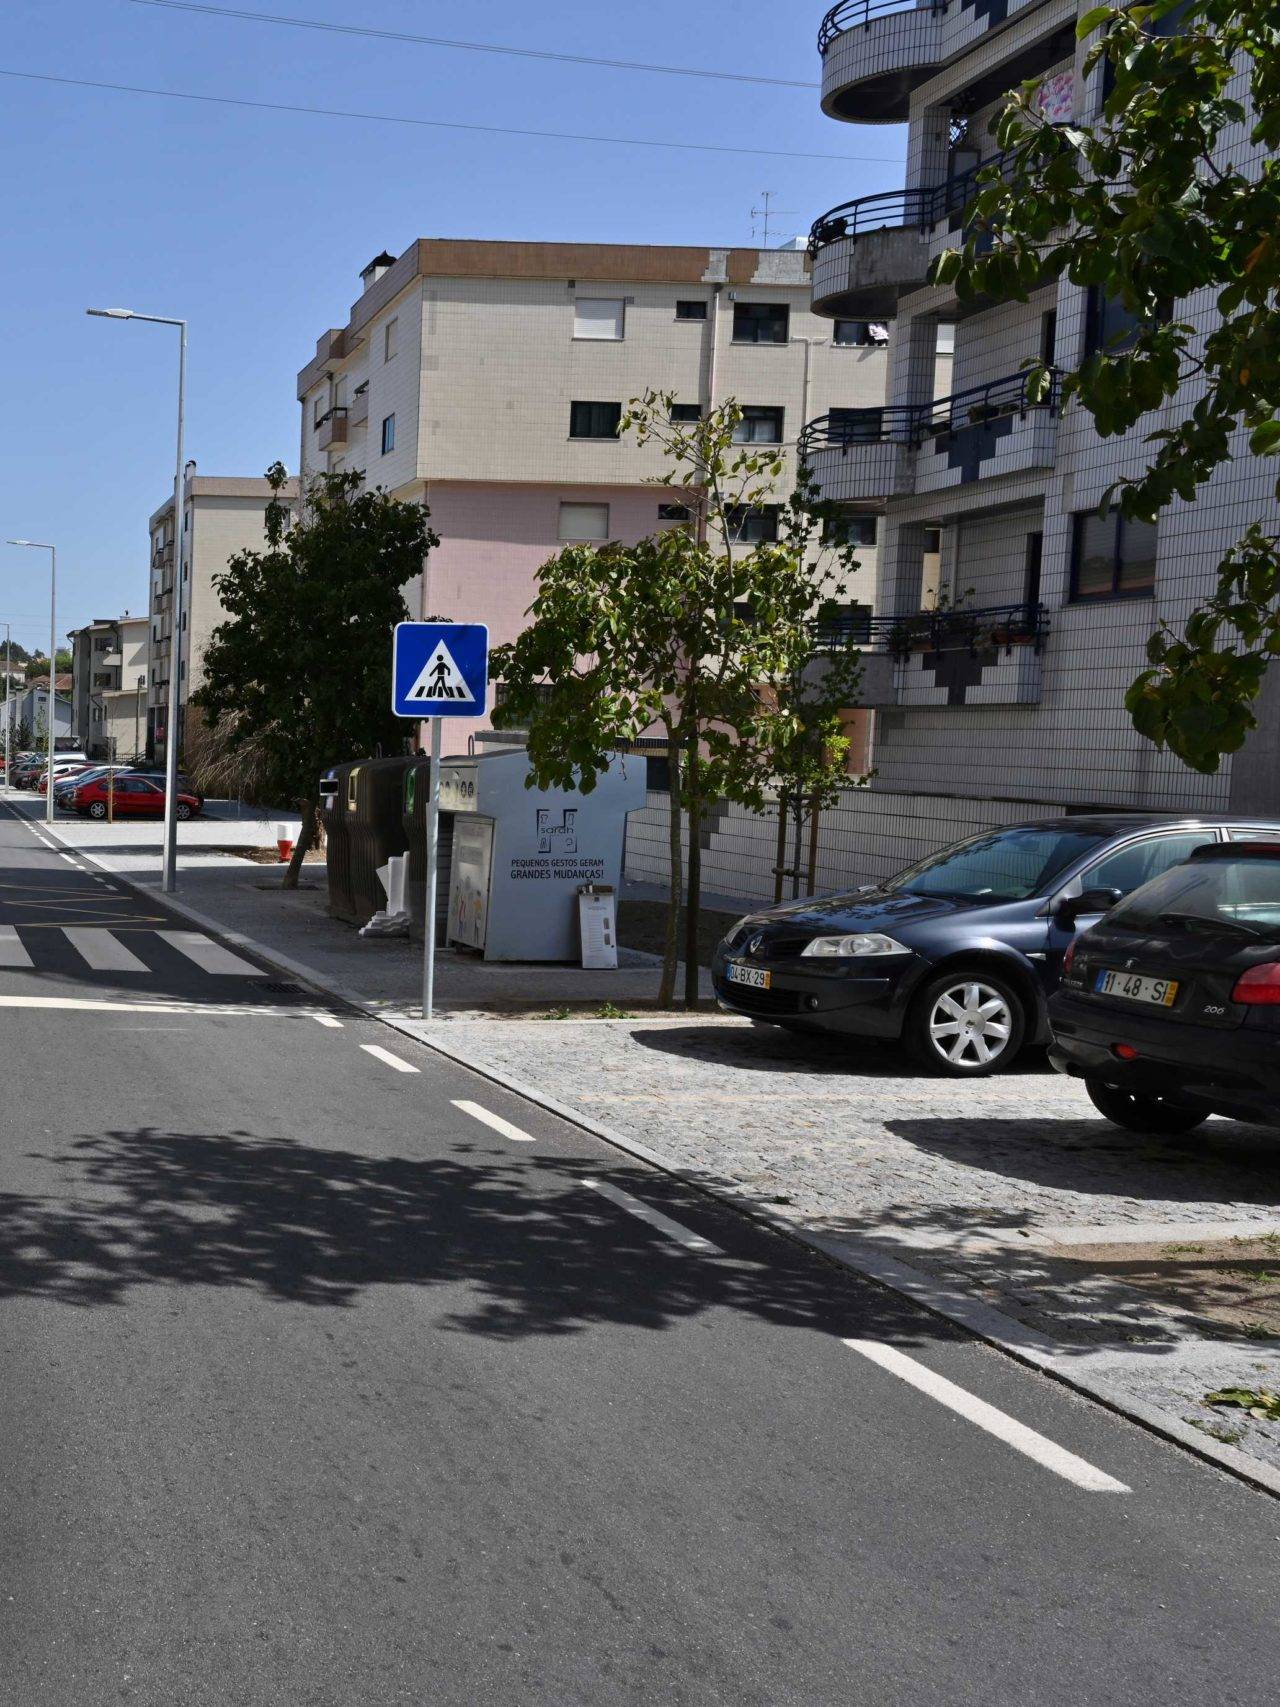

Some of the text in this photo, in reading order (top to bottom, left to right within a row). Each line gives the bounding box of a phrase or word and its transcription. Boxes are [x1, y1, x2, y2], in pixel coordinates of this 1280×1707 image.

[511, 859, 604, 868] PEQUENOS GESTOS GERAM
[510, 870, 551, 879] GRANDES
[1204, 1005, 1225, 1014] 206
